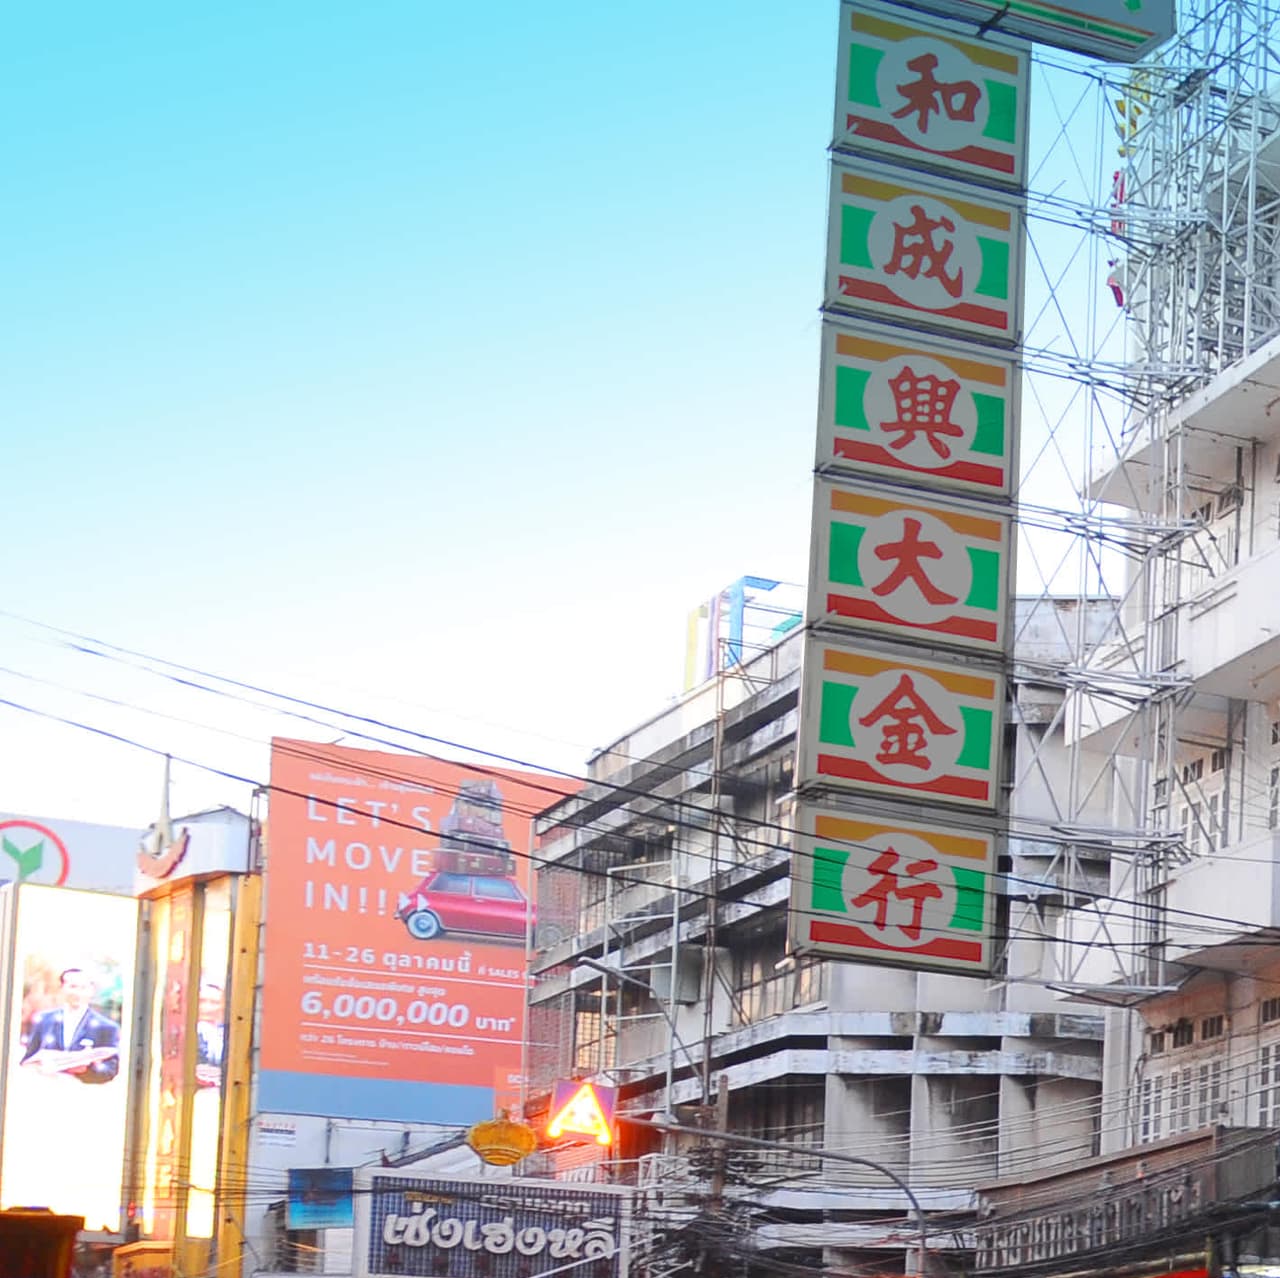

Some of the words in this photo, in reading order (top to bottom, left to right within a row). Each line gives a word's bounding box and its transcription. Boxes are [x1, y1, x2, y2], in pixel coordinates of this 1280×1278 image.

[853, 52, 983, 941] 和成興大金行
[305, 836, 433, 877] MOVE
[300, 990, 470, 1028] 6,000,000
